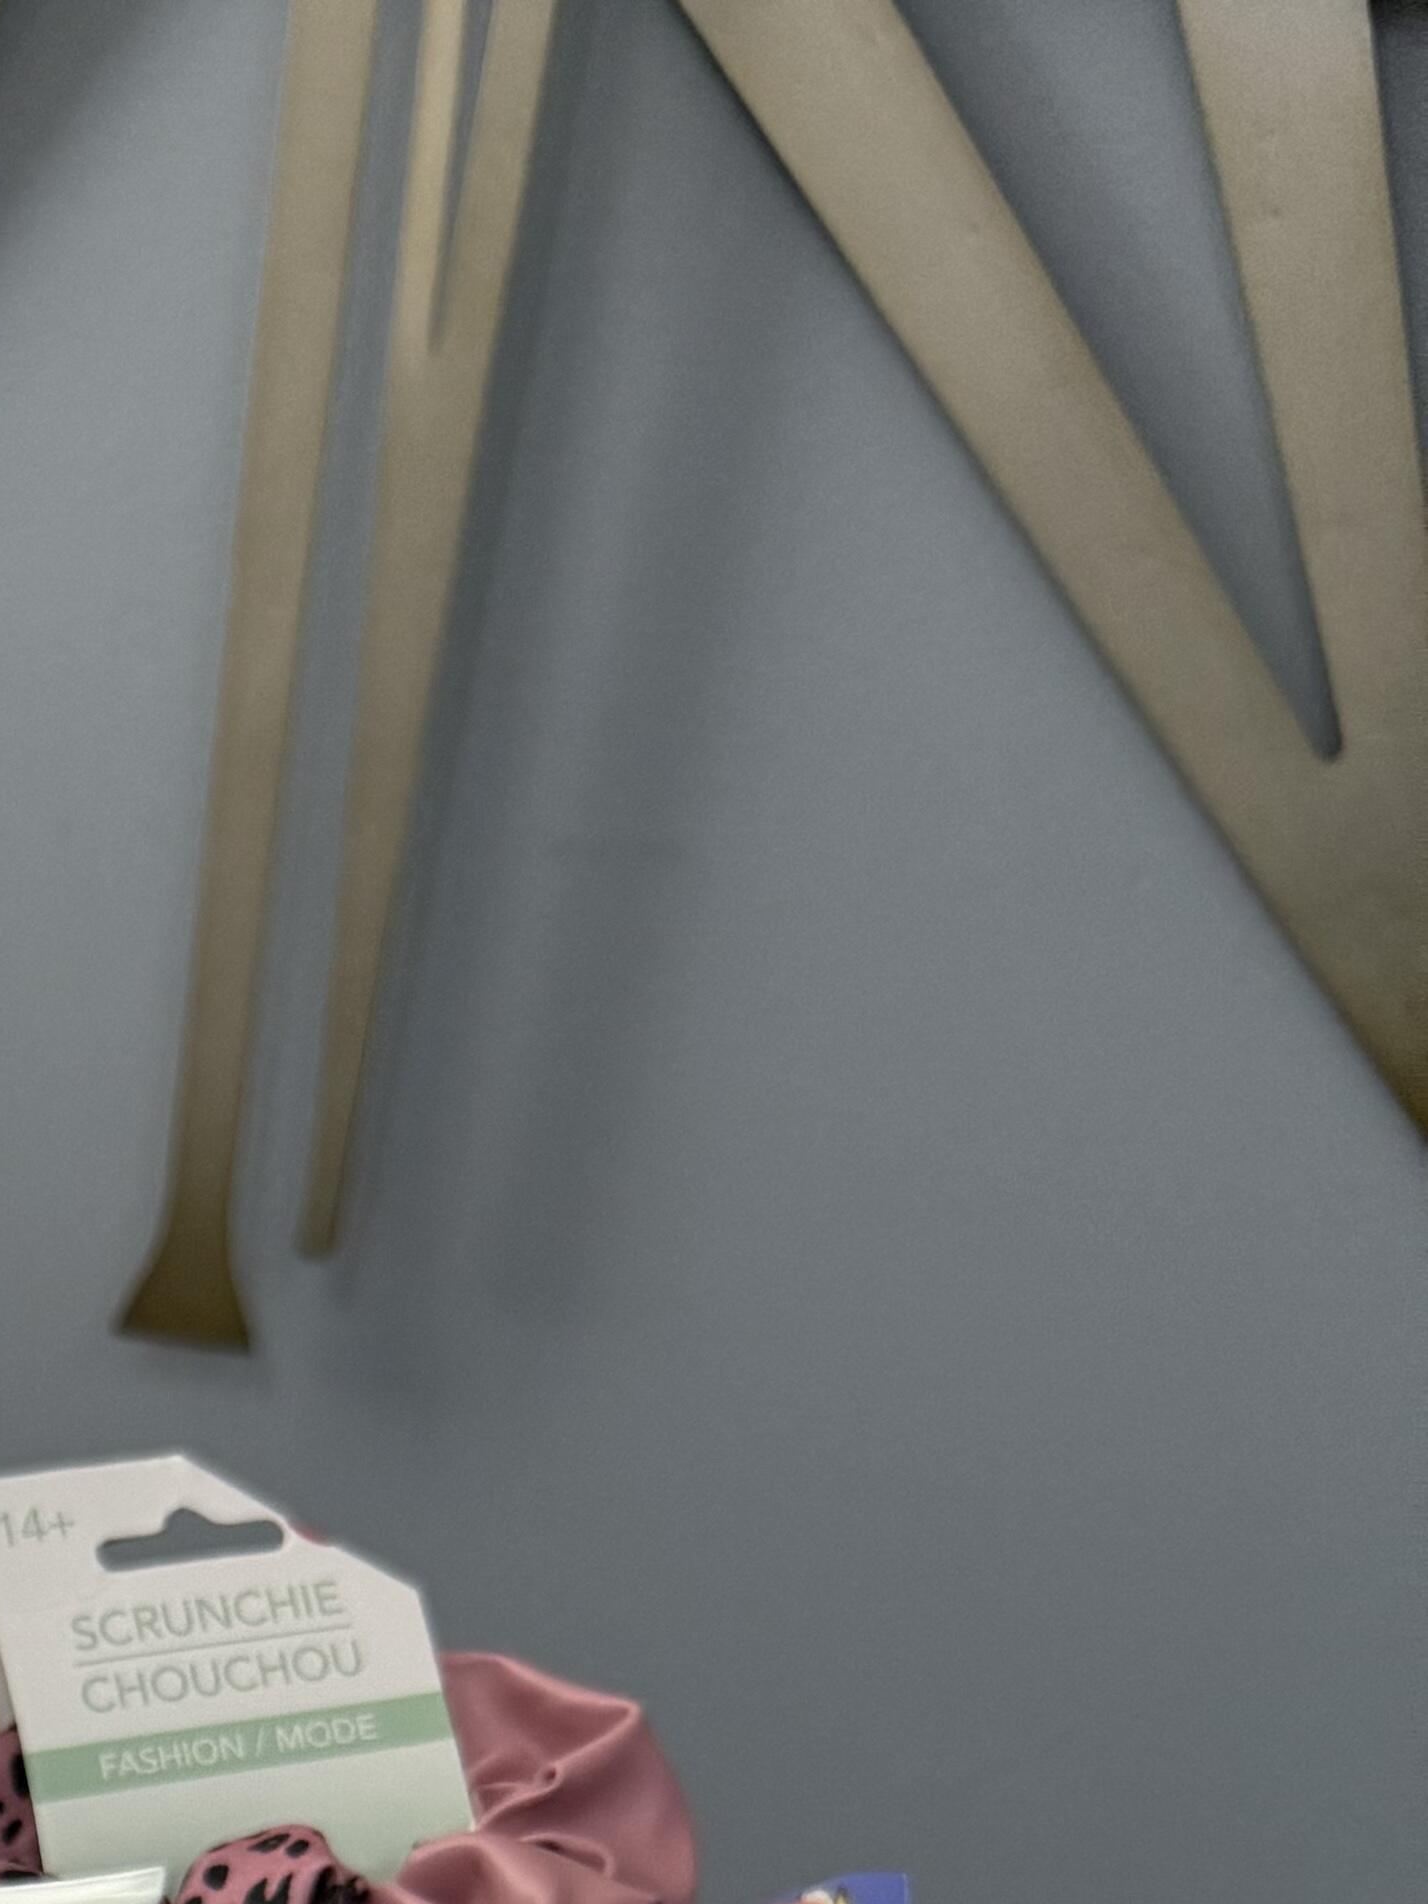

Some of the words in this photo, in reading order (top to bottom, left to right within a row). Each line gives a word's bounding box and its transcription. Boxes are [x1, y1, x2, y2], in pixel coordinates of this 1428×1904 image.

[70, 1578, 345, 1652] SCRUNCHIE
[80, 1640, 363, 1715] CHOUCHOU
[98, 1734, 246, 1781] FASHION
[275, 1711, 379, 1749] MODE
